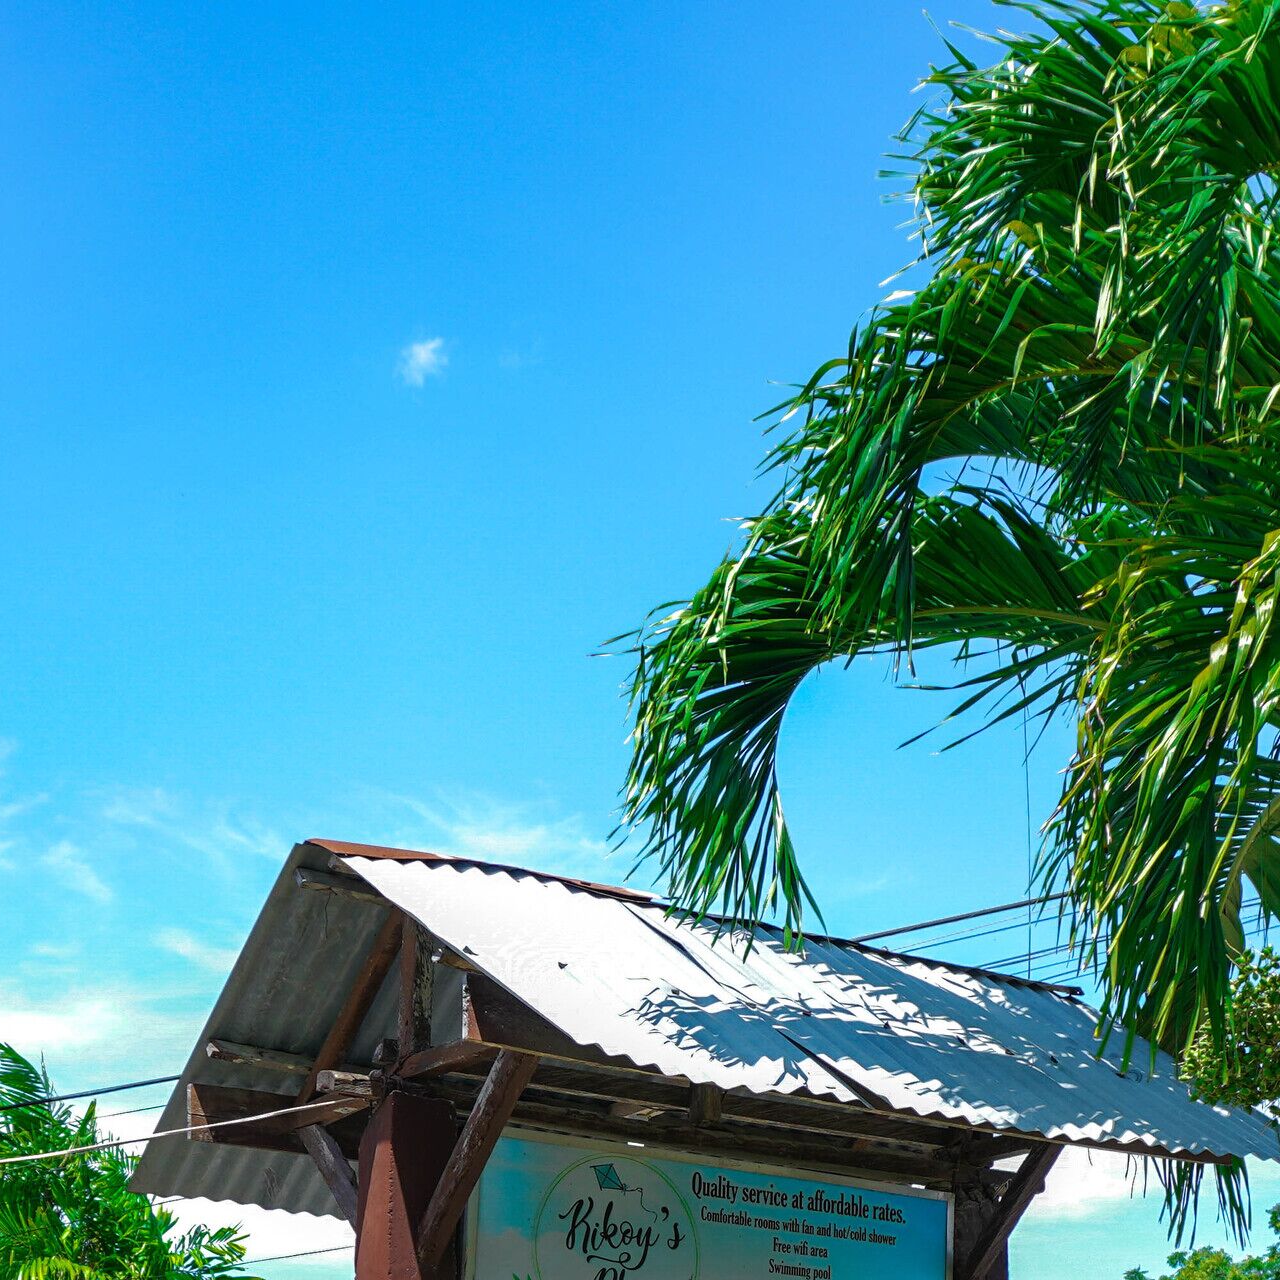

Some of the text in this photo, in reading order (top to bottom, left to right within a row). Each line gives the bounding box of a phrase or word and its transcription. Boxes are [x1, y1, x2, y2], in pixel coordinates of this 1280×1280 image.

[692, 1172, 906, 1224] Quality service at affordable rates.
[558, 1196, 686, 1271] Kikoy's
[701, 1206, 897, 1245] Comfortable rooms with fan and hot/cold shower
[773, 1237, 828, 1258] Free wifi area
[769, 1259, 831, 1280] Swimming pool
